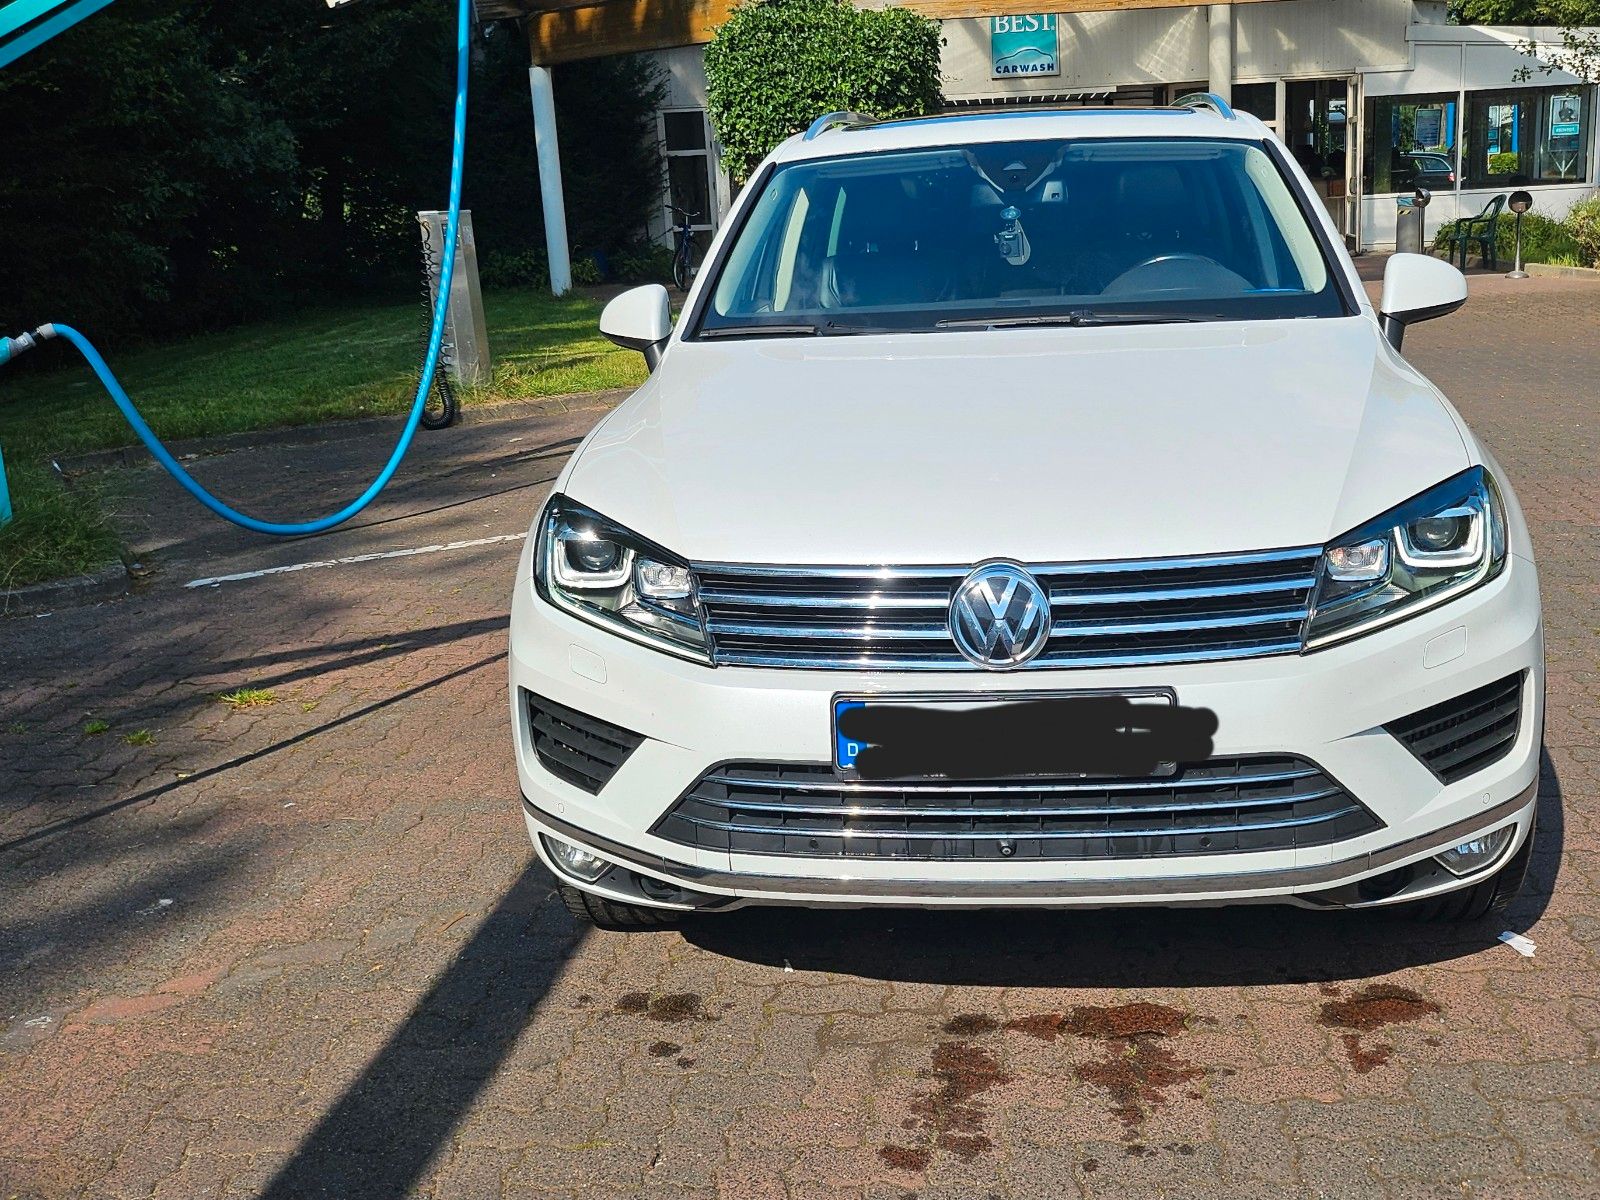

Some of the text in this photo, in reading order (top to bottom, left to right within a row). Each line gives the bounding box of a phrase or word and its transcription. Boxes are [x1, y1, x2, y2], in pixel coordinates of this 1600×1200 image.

[995, 63, 1054, 74] CARWASH
[956, 572, 1044, 664] VW
[847, 742, 859, 757] D
